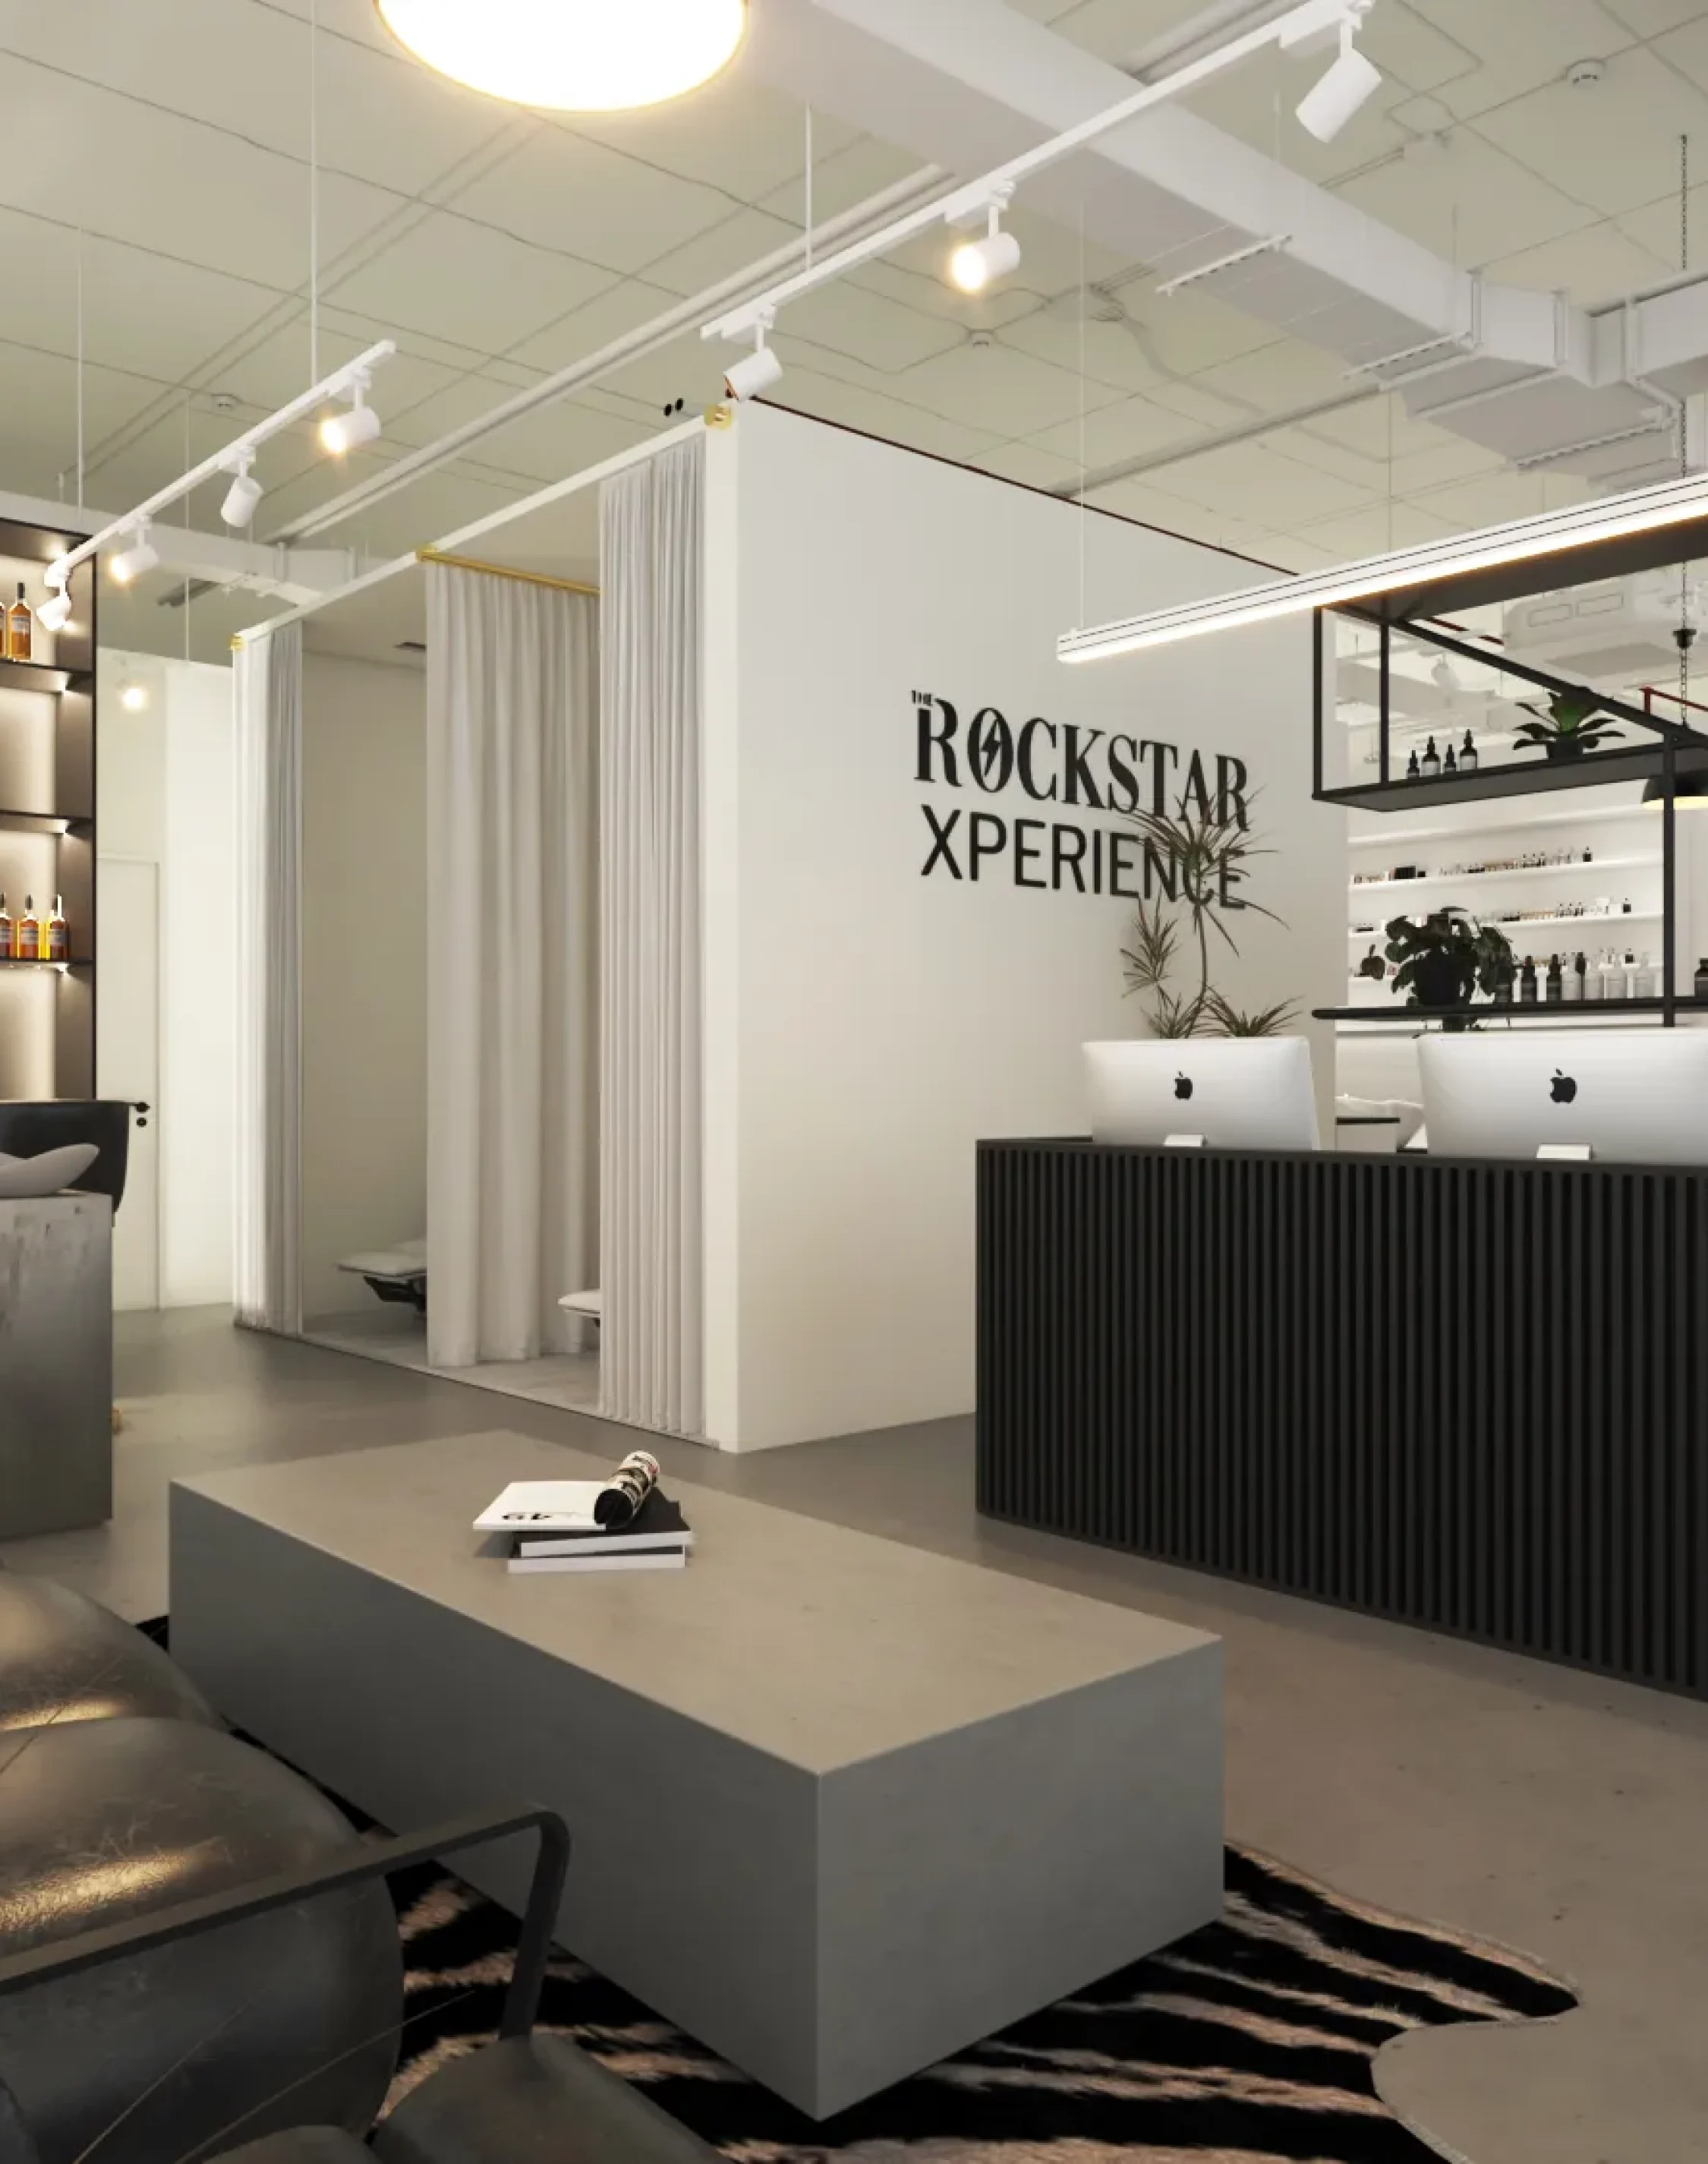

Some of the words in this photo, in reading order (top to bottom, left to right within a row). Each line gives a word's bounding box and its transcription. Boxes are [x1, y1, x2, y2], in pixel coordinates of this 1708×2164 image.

[911, 689, 933, 707] THE
[914, 698, 1250, 831] ROCKSTAR
[921, 804, 1246, 909] XPERIENCE
